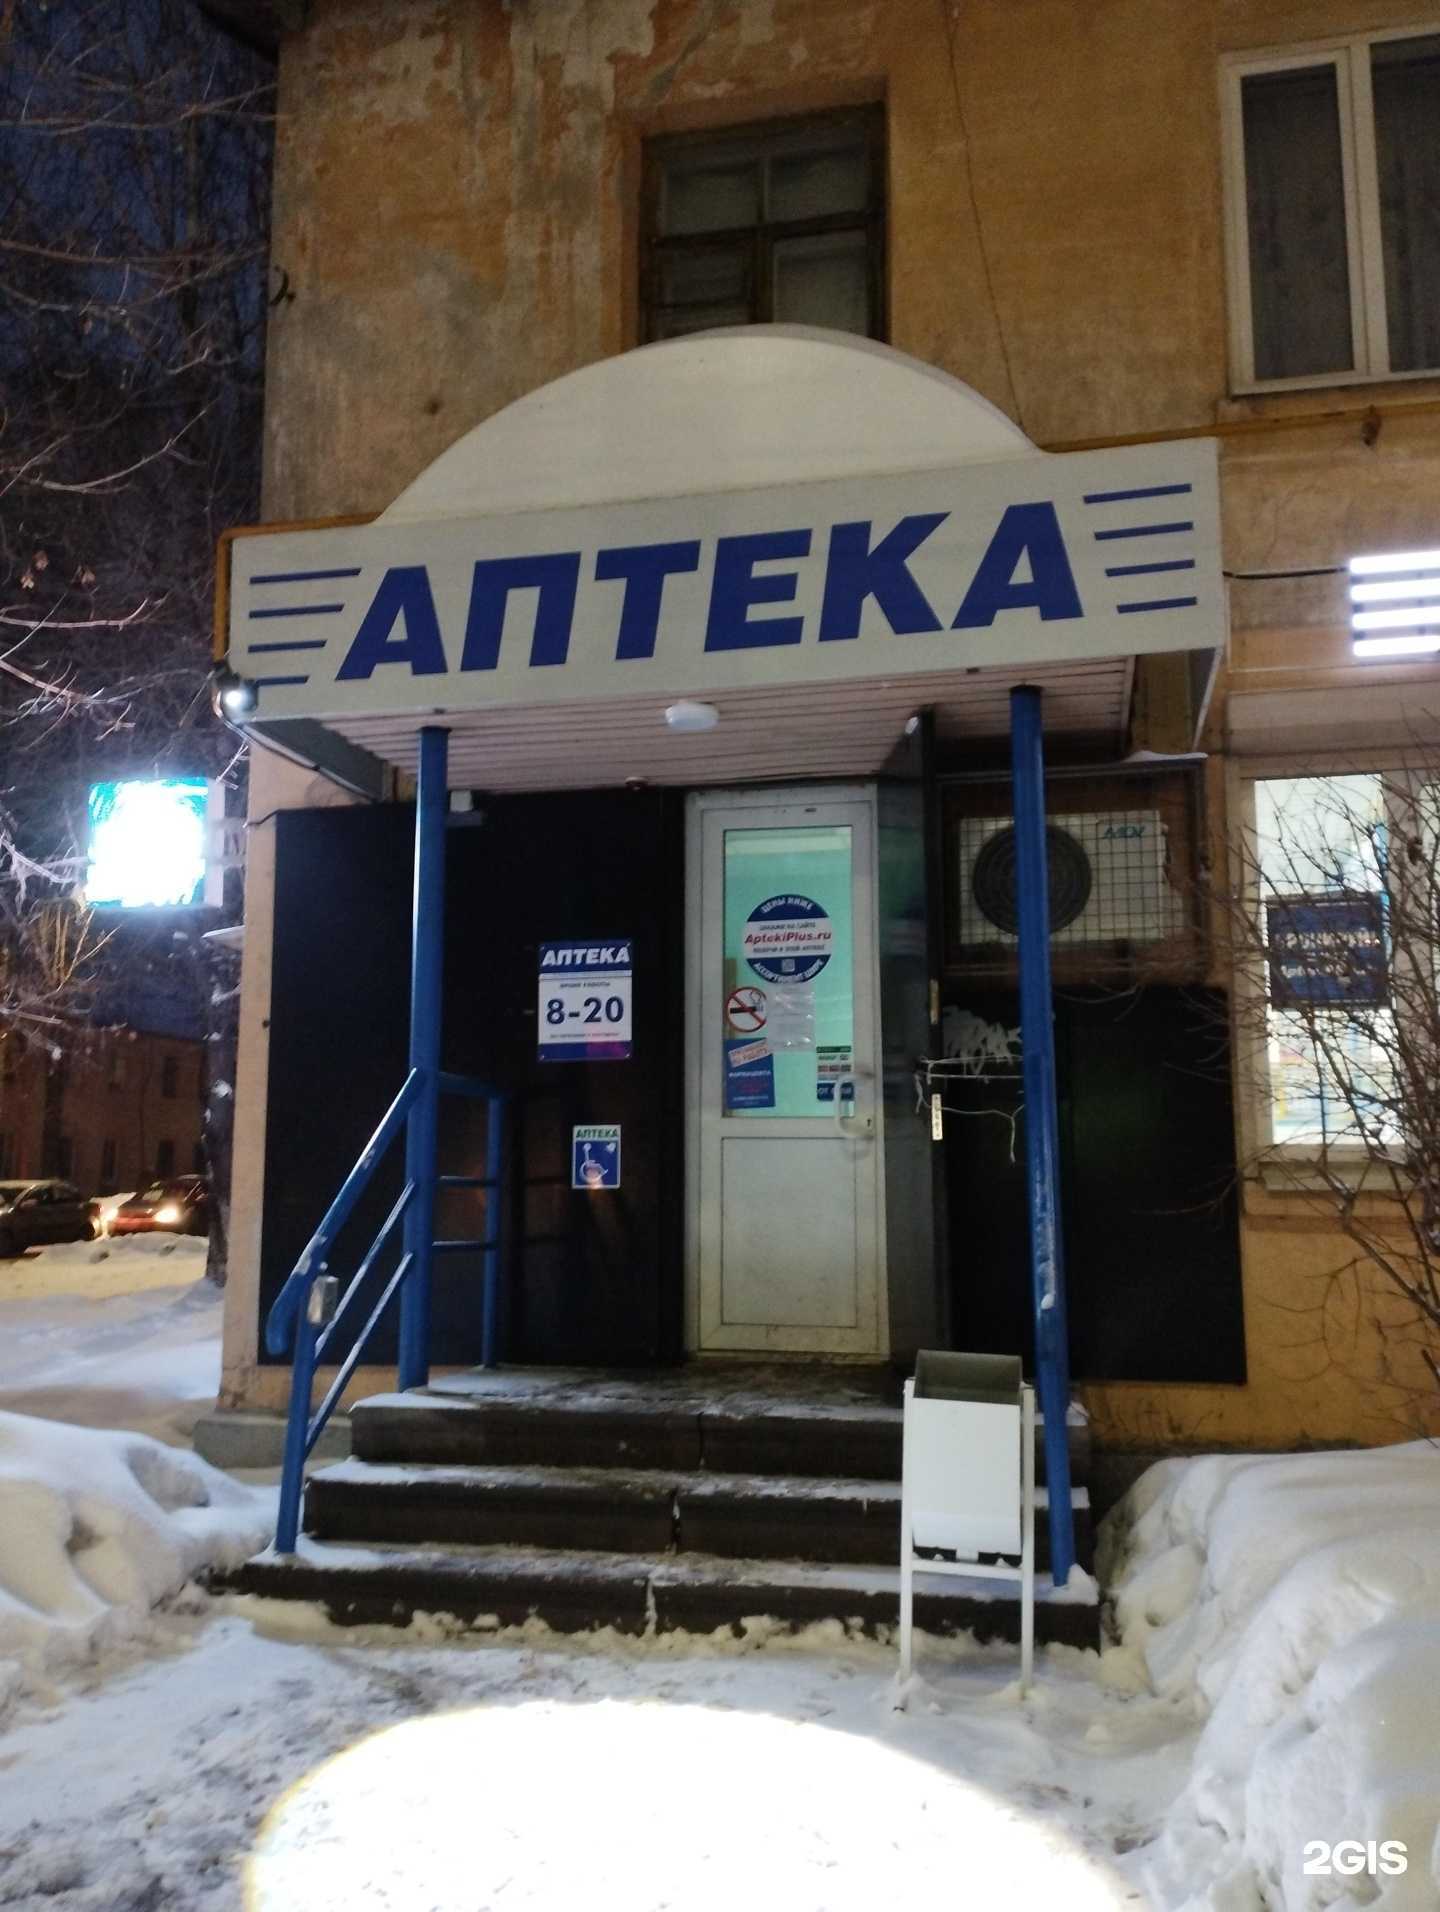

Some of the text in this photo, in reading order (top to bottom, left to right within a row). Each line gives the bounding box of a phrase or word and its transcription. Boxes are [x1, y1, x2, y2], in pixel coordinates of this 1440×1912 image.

[335, 501, 1083, 681] АПТЕКА
[744, 931, 832, 945] AptekiPlus.ru
[541, 946, 631, 967] АПТЕКА
[546, 996, 625, 1025] 8-20
[576, 1128, 618, 1138] АПТЕКА
